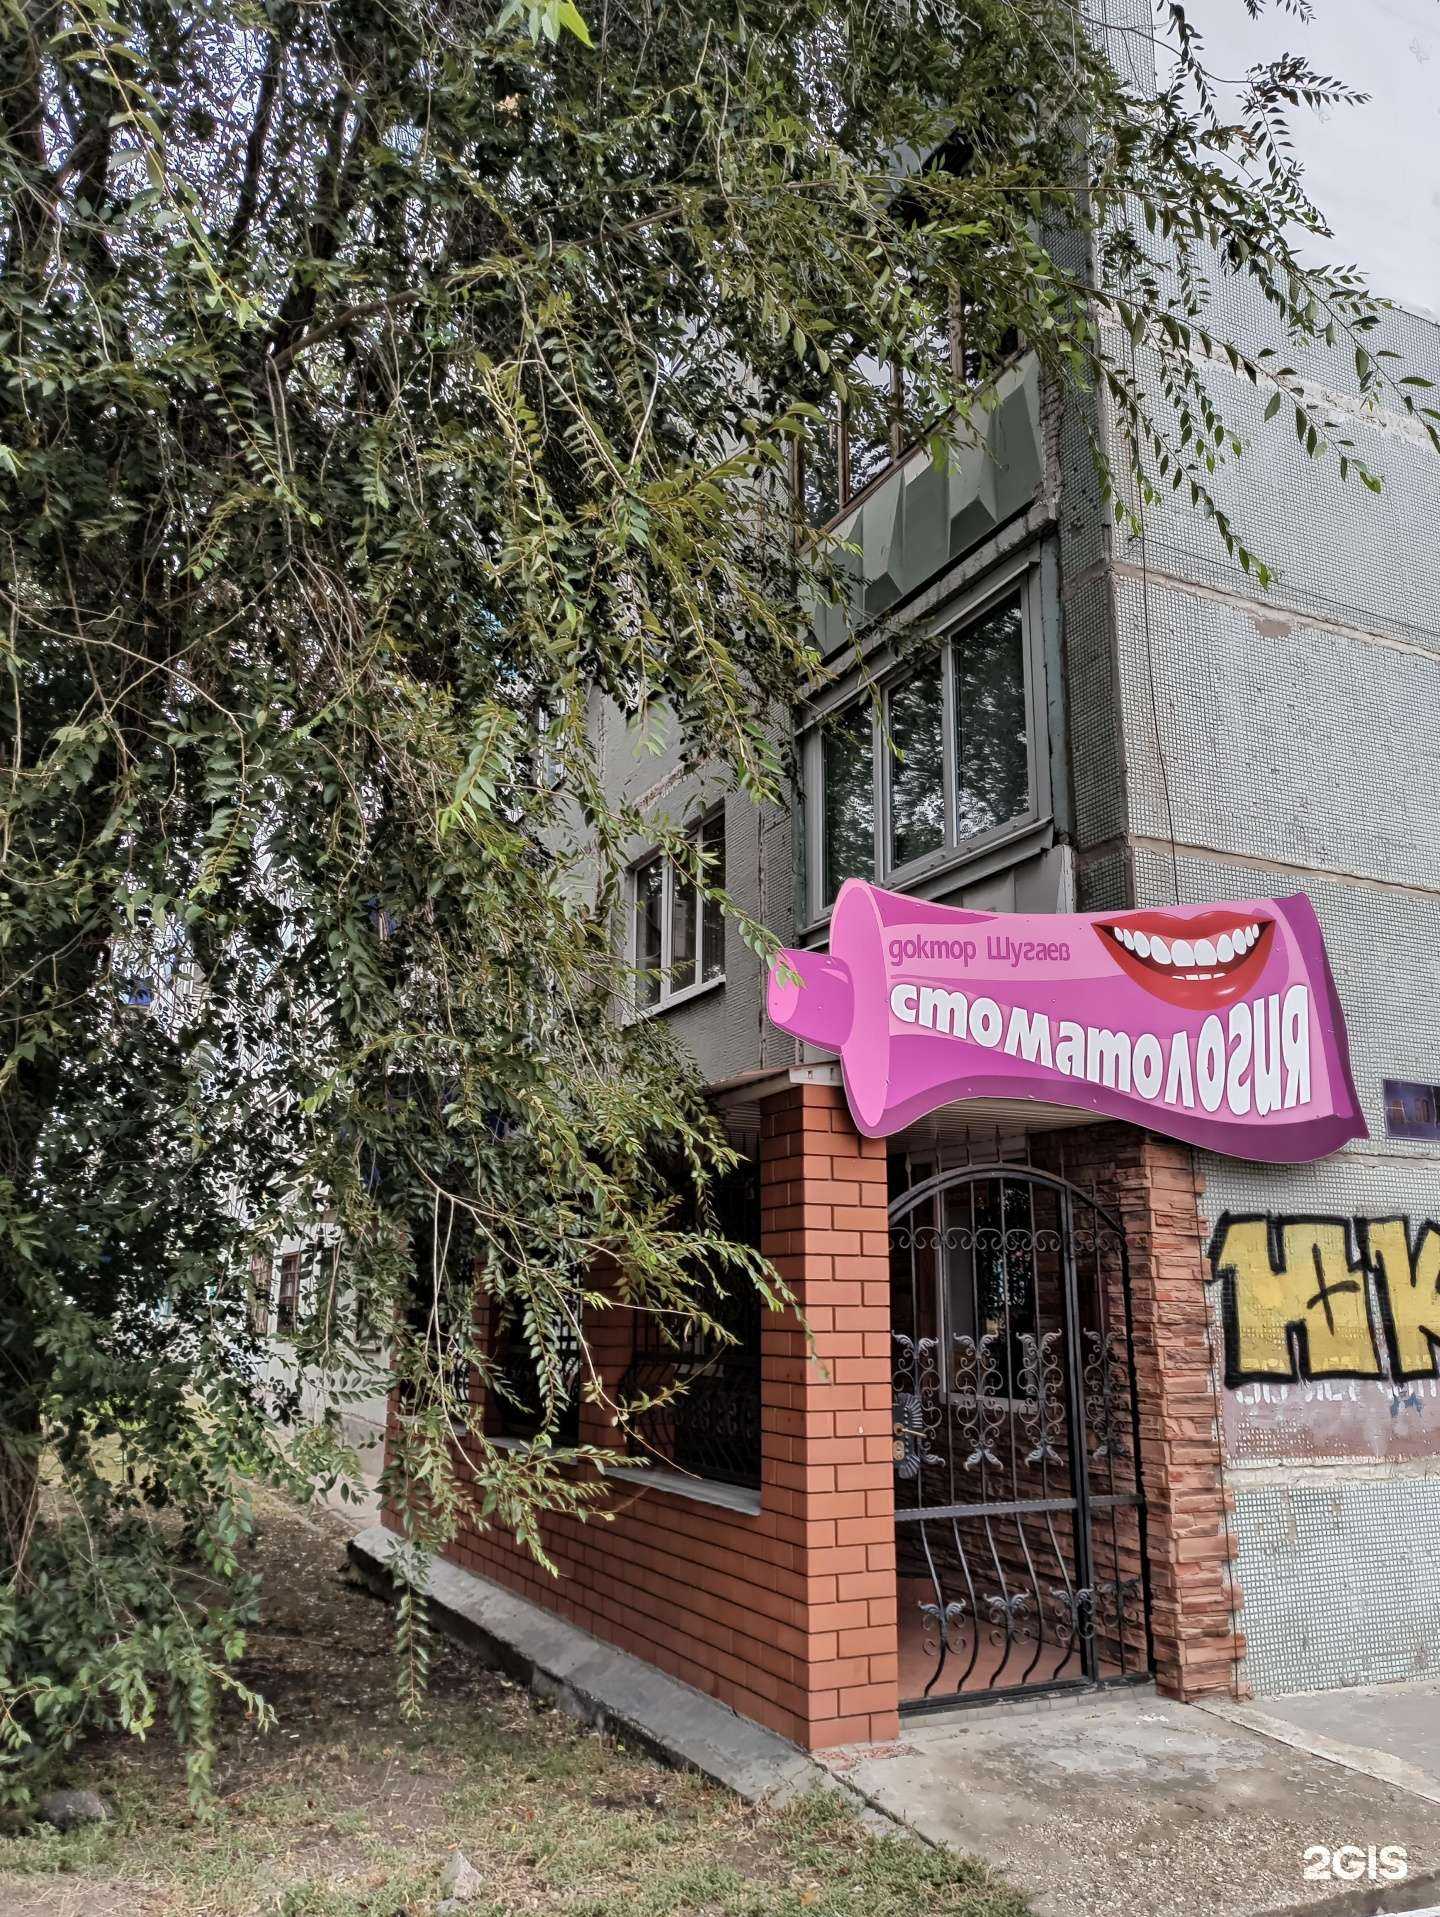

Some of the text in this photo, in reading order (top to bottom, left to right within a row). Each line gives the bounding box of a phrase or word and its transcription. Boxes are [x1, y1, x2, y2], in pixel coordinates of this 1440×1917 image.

[889, 934, 1071, 967] доктор Шугаев
[890, 983, 1312, 1117] стоматология
